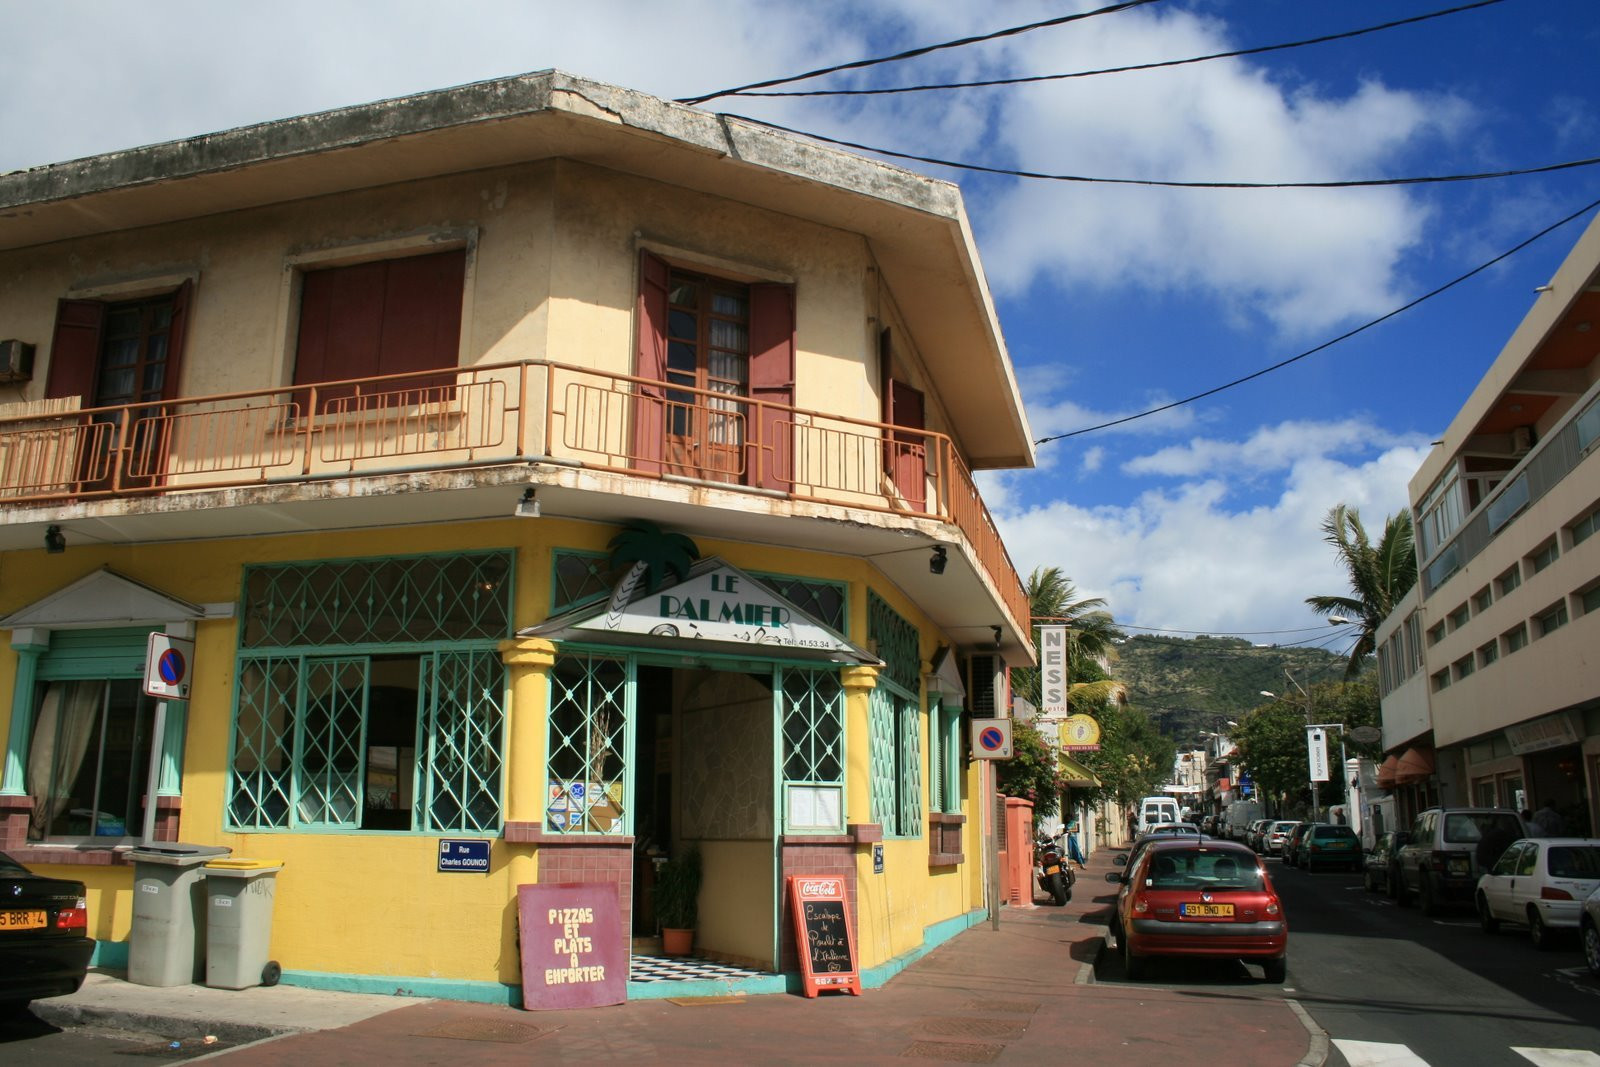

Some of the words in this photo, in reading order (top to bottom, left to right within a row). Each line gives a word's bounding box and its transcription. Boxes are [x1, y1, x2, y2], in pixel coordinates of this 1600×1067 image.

[711, 573, 739, 594] LE
[659, 594, 791, 630] PALMIER
[798, 639, 829, 648] 41.53.34
[1045, 631, 1062, 704] NESS
[458, 845, 470, 854] Rue
[441, 857, 461, 866] Charles
[462, 858, 487, 867] GOUNOD
[9, 911, 30, 926] BRR
[1186, 905, 1201, 915] 591
[563, 922, 579, 939] ET
[808, 929, 836, 946] Poulet
[554, 936, 593, 955] PLATS
[570, 952, 579, 969] A
[545, 965, 605, 986] EMPORTER
